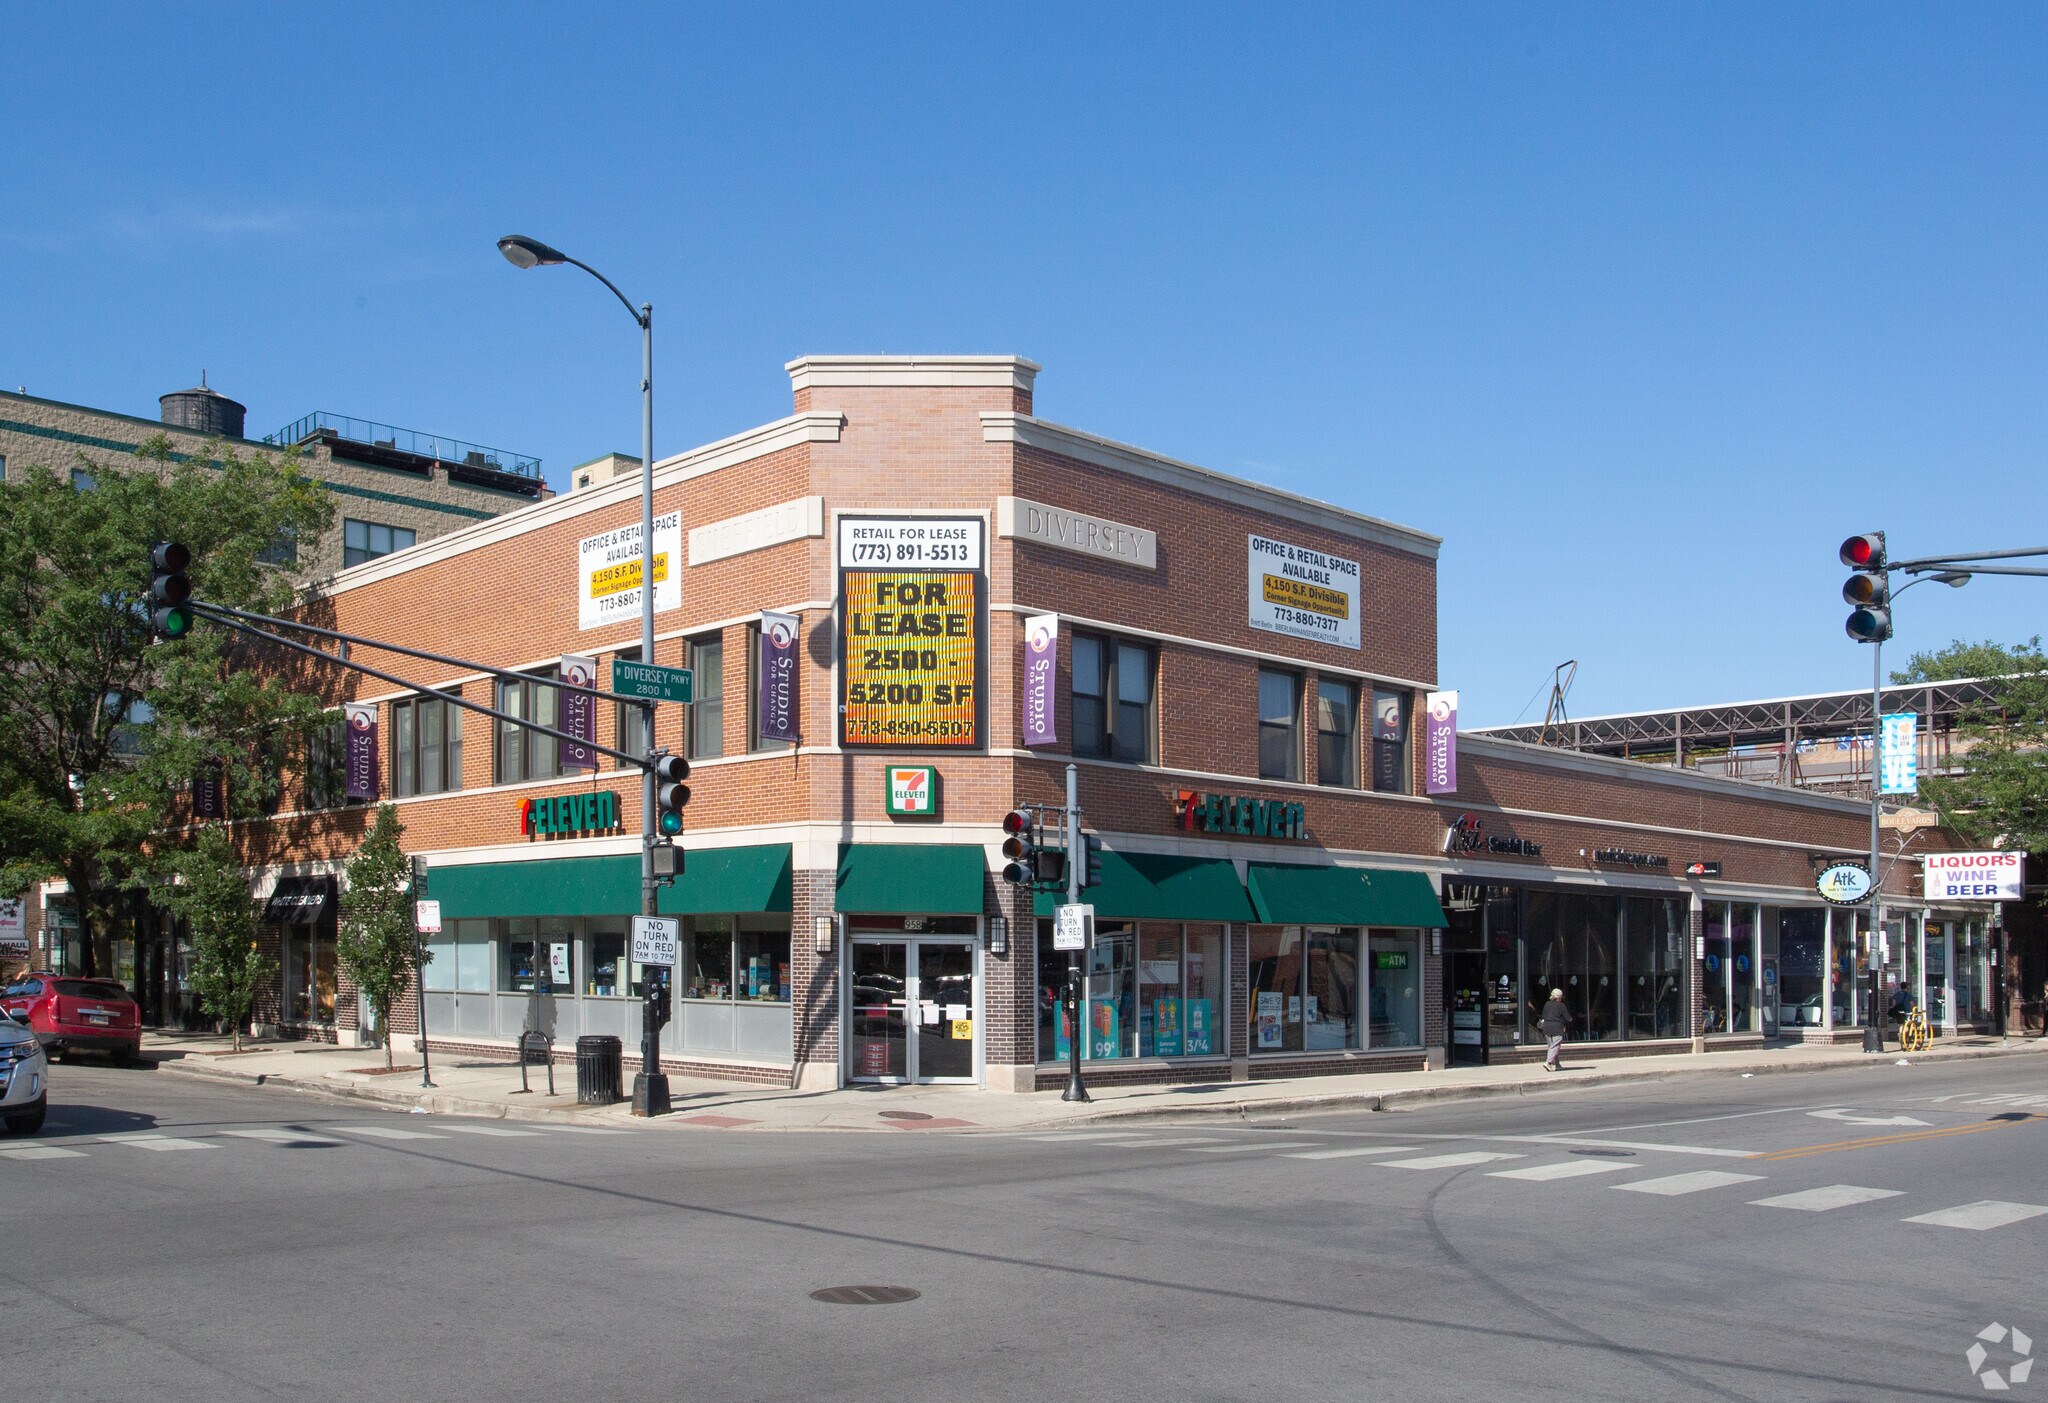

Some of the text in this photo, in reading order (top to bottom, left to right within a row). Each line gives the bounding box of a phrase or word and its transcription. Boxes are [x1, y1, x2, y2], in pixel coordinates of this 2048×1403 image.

[582, 535, 610, 553] OFFICE
[611, 532, 618, 545] &
[620, 524, 643, 542] RETAI
[853, 528, 967, 540] RETAIL FOR LEASE
[1028, 507, 1144, 559] DIVERSEY
[606, 541, 643, 563] AVAILABL
[852, 543, 968, 563] (773) 891-5513
[1253, 538, 1357, 576] OFFICE & RETAIL SPACE
[614, 565, 628, 577] S.F.
[629, 557, 665, 574] Divble
[1282, 562, 1330, 585] AVAILABLE
[593, 570, 665, 595] Corner Signage Oppnity
[1265, 577, 1345, 606] 4,150 S.F. Divisible
[600, 586, 658, 611] 773-880-77
[877, 583, 948, 606] FOR
[1266, 591, 1345, 617] Corner Signage Opportunity
[853, 612, 968, 637] LEASE
[1274, 607, 1339, 631] 773-880-7377
[864, 649, 937, 670] 2500
[615, 666, 690, 685] W DIVERSEY PKWY
[636, 683, 671, 696] 2800 N
[777, 657, 793, 730] STUDIO
[850, 683, 973, 706] 5200 SF
[1034, 659, 1049, 734] STUDIO
[574, 695, 589, 759] STUDO
[359, 736, 372, 790] STUDIO
[1437, 727, 1450, 785] STUDIO
[1881, 815, 1933, 826] BOULEVARDS
[1929, 855, 2017, 868] LIQUORS
[1832, 871, 1857, 886] Atk
[1946, 870, 1997, 882] WINE
[1946, 884, 1998, 896] BEER
[1060, 918, 1078, 927] TURN
[1063, 908, 1074, 917] NO
[648, 921, 664, 931] NO
[905, 920, 922, 929] 958
[1057, 927, 1082, 936] ON RED
[635, 940, 674, 952] ON RED
[643, 931, 669, 941] TURN
[635, 951, 649, 959] 7AM
[660, 952, 675, 961] 7PM
[1388, 955, 1406, 966] ATM
[1095, 1041, 1116, 1057] 99¢
[1187, 1039, 1209, 1052] 3/$4
